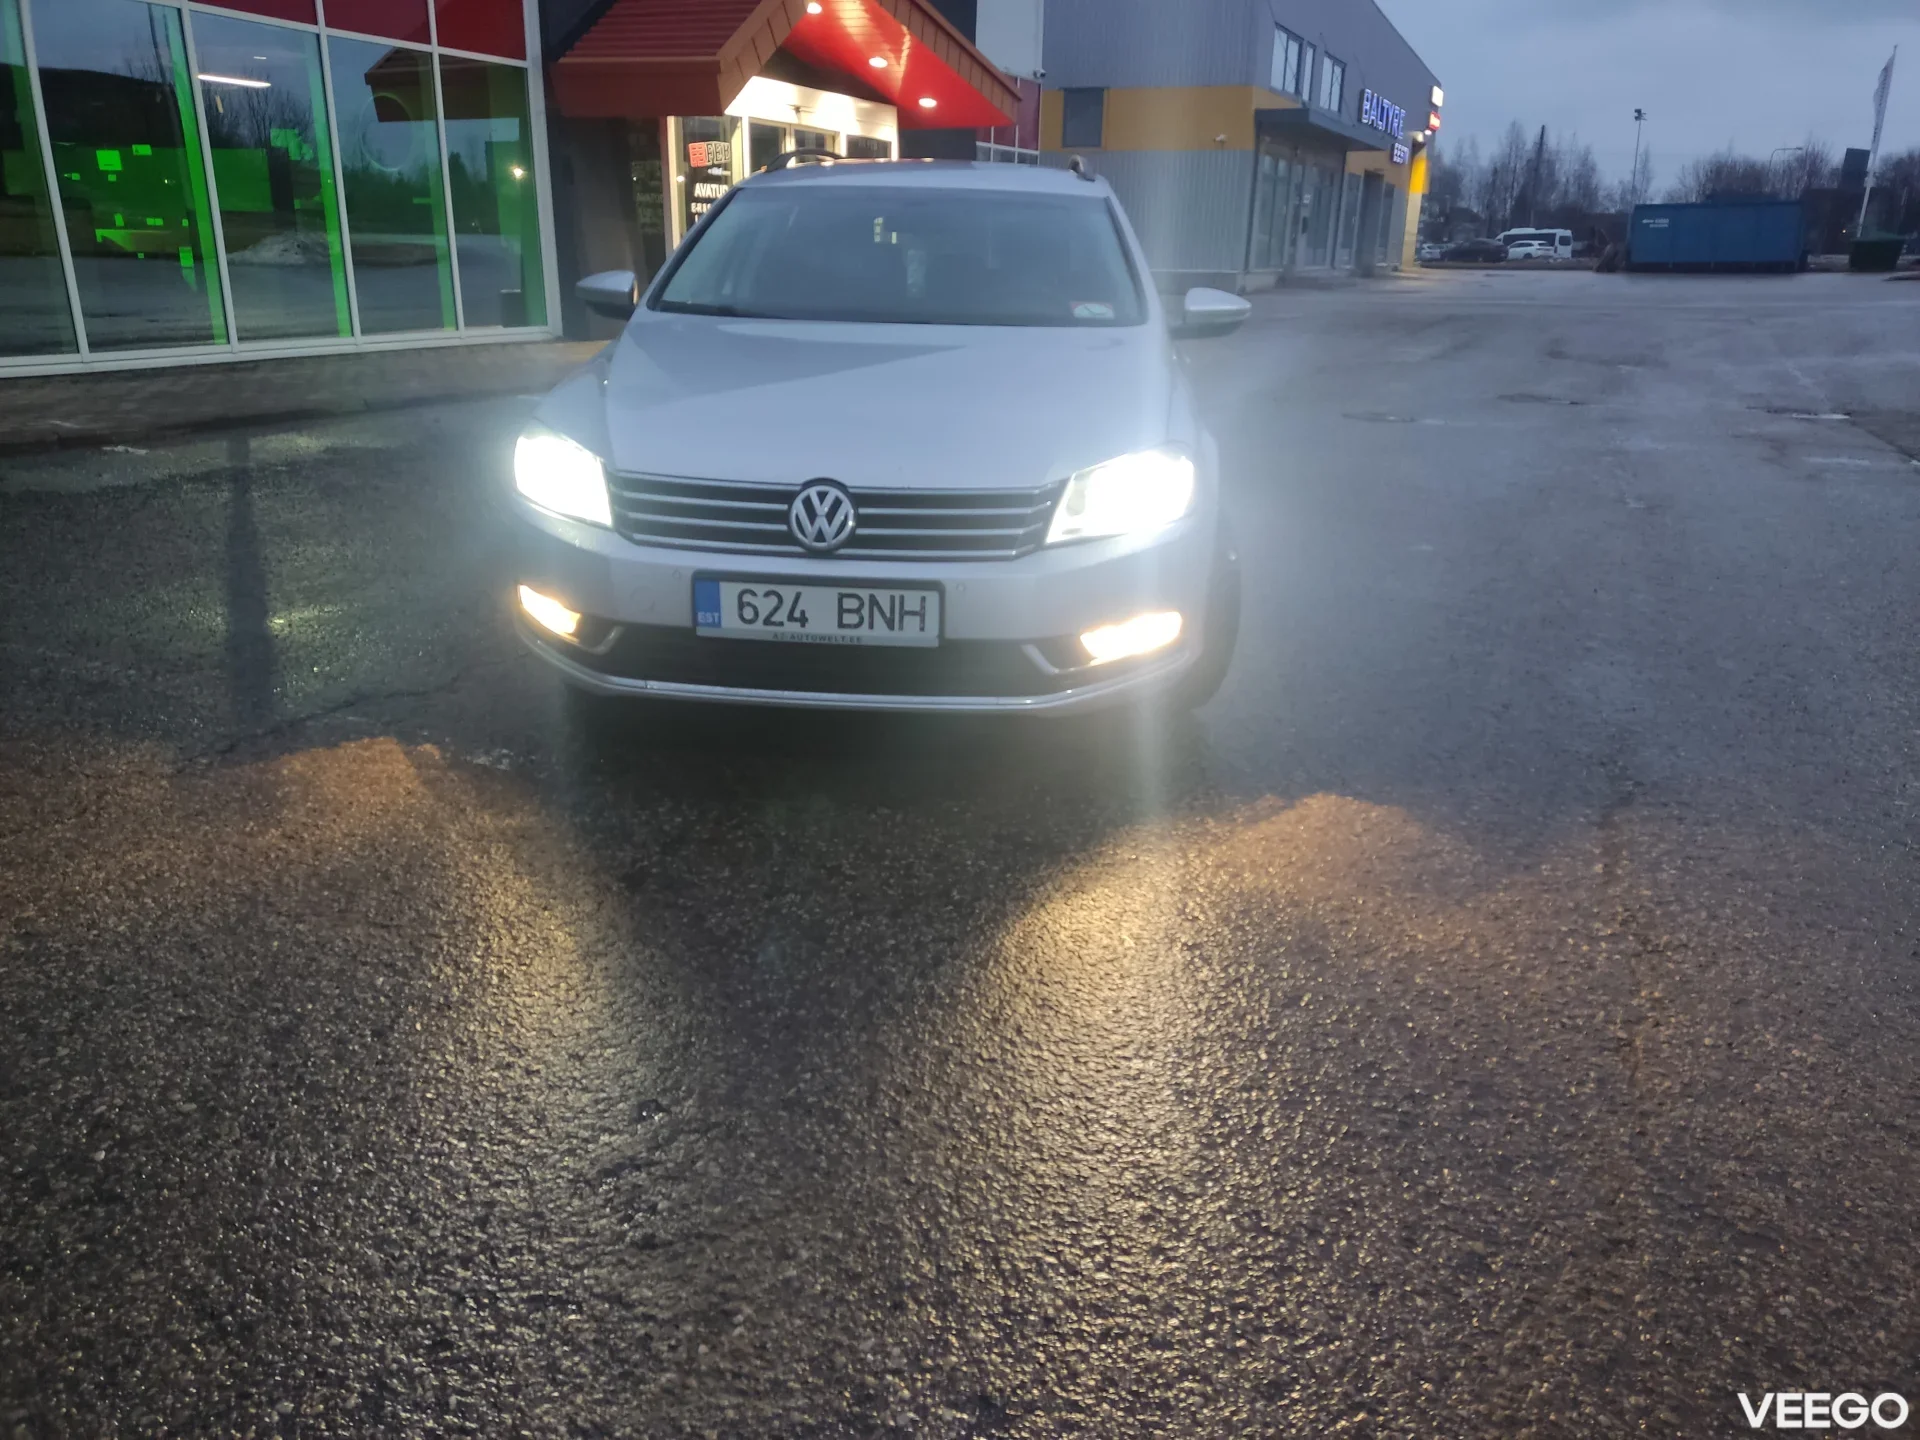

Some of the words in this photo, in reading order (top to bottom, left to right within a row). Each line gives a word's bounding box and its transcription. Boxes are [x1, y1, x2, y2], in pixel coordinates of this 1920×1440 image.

[1362, 88, 1406, 139] BALTYRE
[790, 485, 854, 548] VW
[737, 588, 809, 628] 624
[837, 592, 926, 632] BNH
